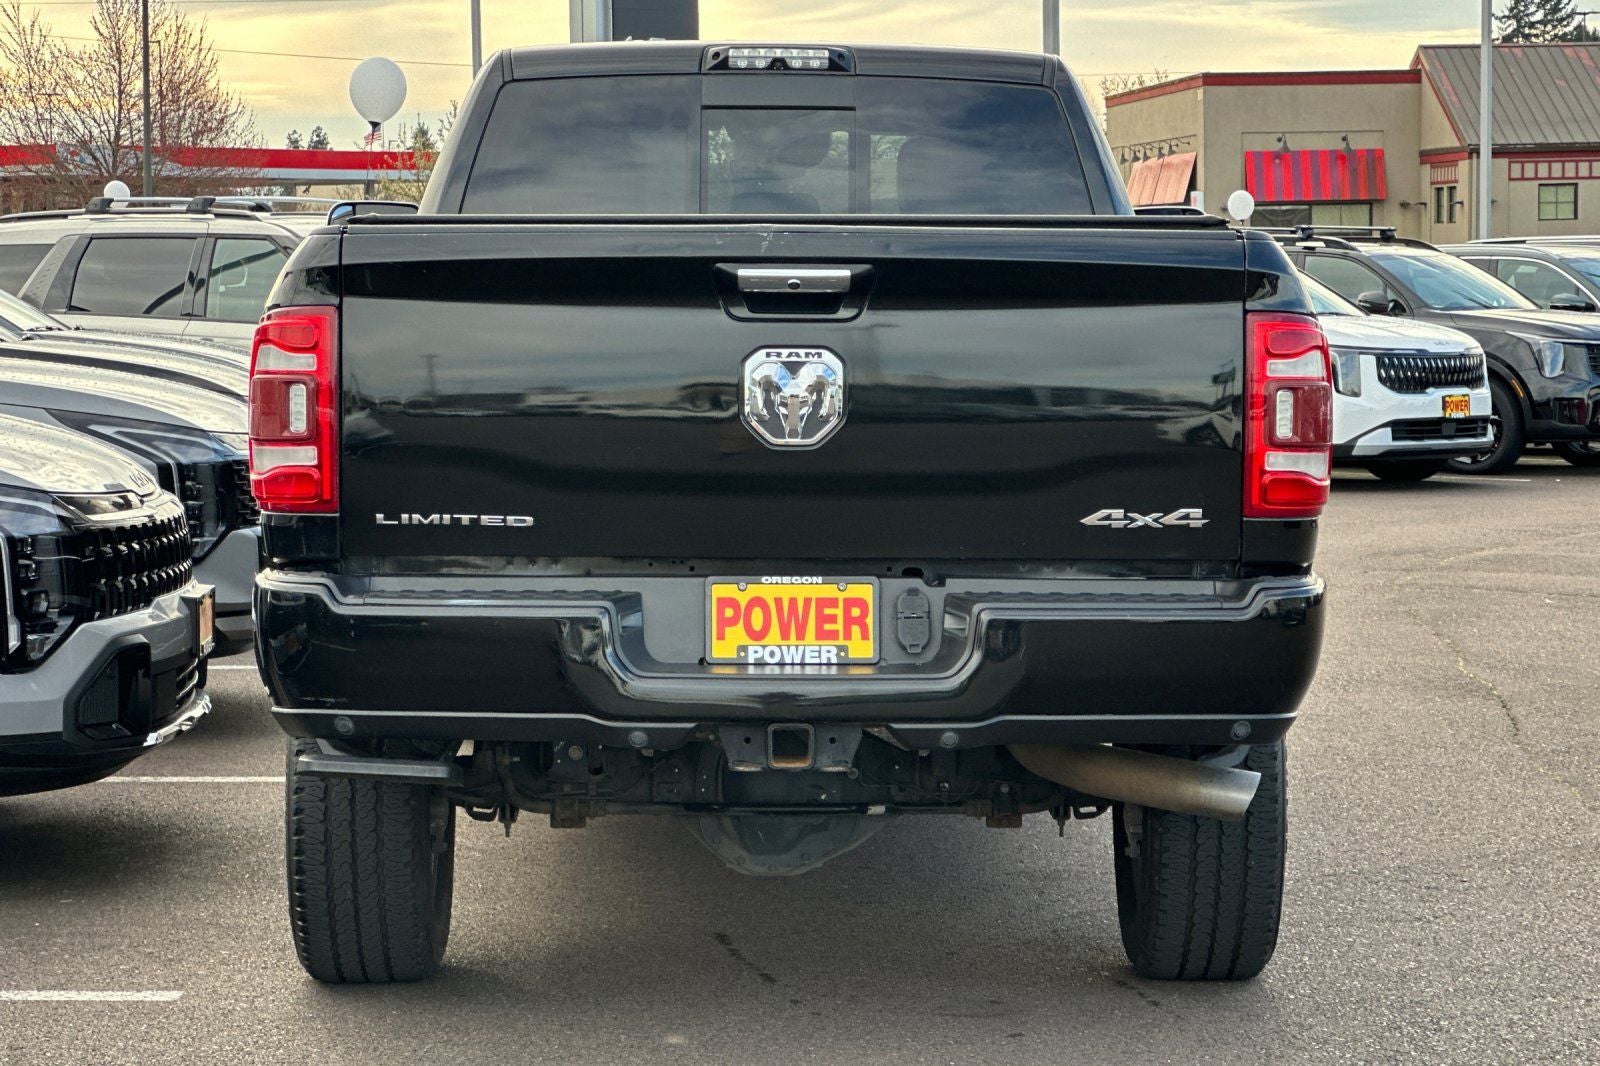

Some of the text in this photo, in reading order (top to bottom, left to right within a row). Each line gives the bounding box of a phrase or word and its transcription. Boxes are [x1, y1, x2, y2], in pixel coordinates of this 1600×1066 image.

[765, 351, 823, 359] RAM
[1445, 399, 1469, 412] POWER
[375, 513, 534, 527] LIMITED
[1079, 508, 1211, 529] 4x4
[761, 576, 823, 584] OREGON
[716, 596, 870, 642] POWER
[748, 645, 838, 664] POWER
